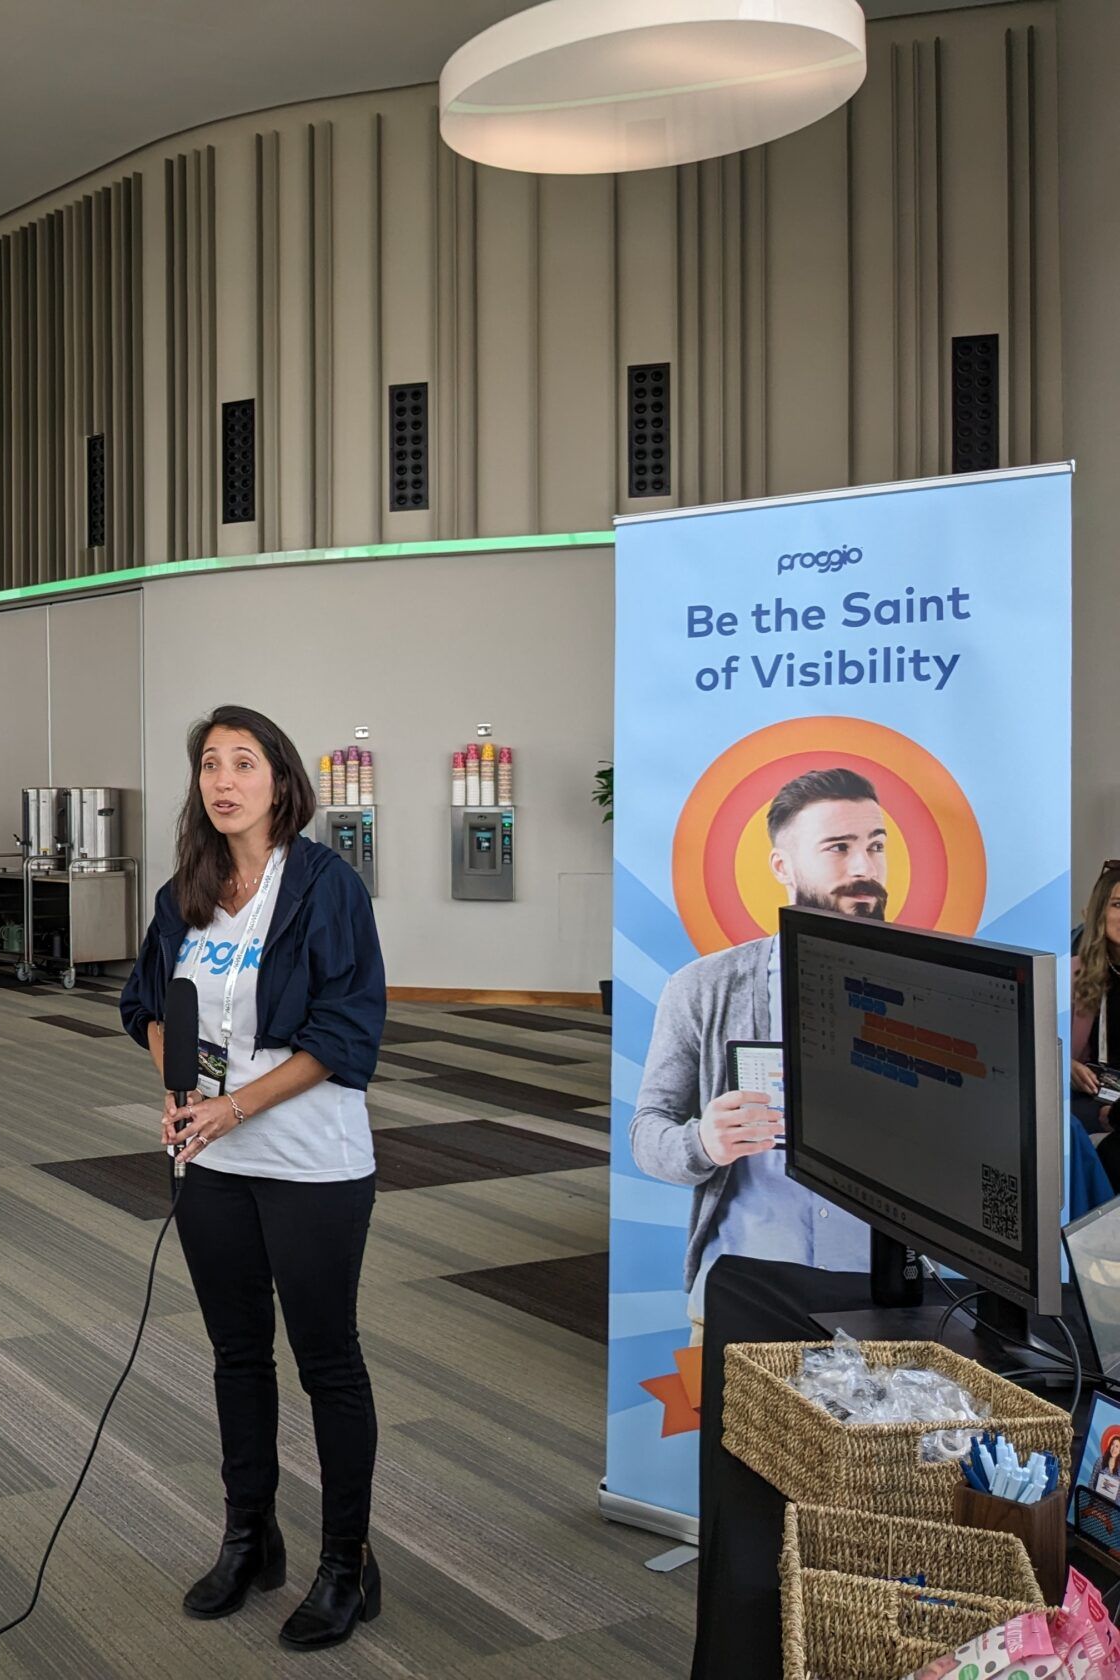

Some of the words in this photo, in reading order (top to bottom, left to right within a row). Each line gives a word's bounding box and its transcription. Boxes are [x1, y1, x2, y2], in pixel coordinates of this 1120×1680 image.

[777, 544, 863, 576] proggio
[686, 604, 739, 639] Be
[750, 597, 827, 634] the
[841, 586, 972, 628] Saint
[695, 655, 740, 692] of
[750, 645, 961, 691] Visibility
